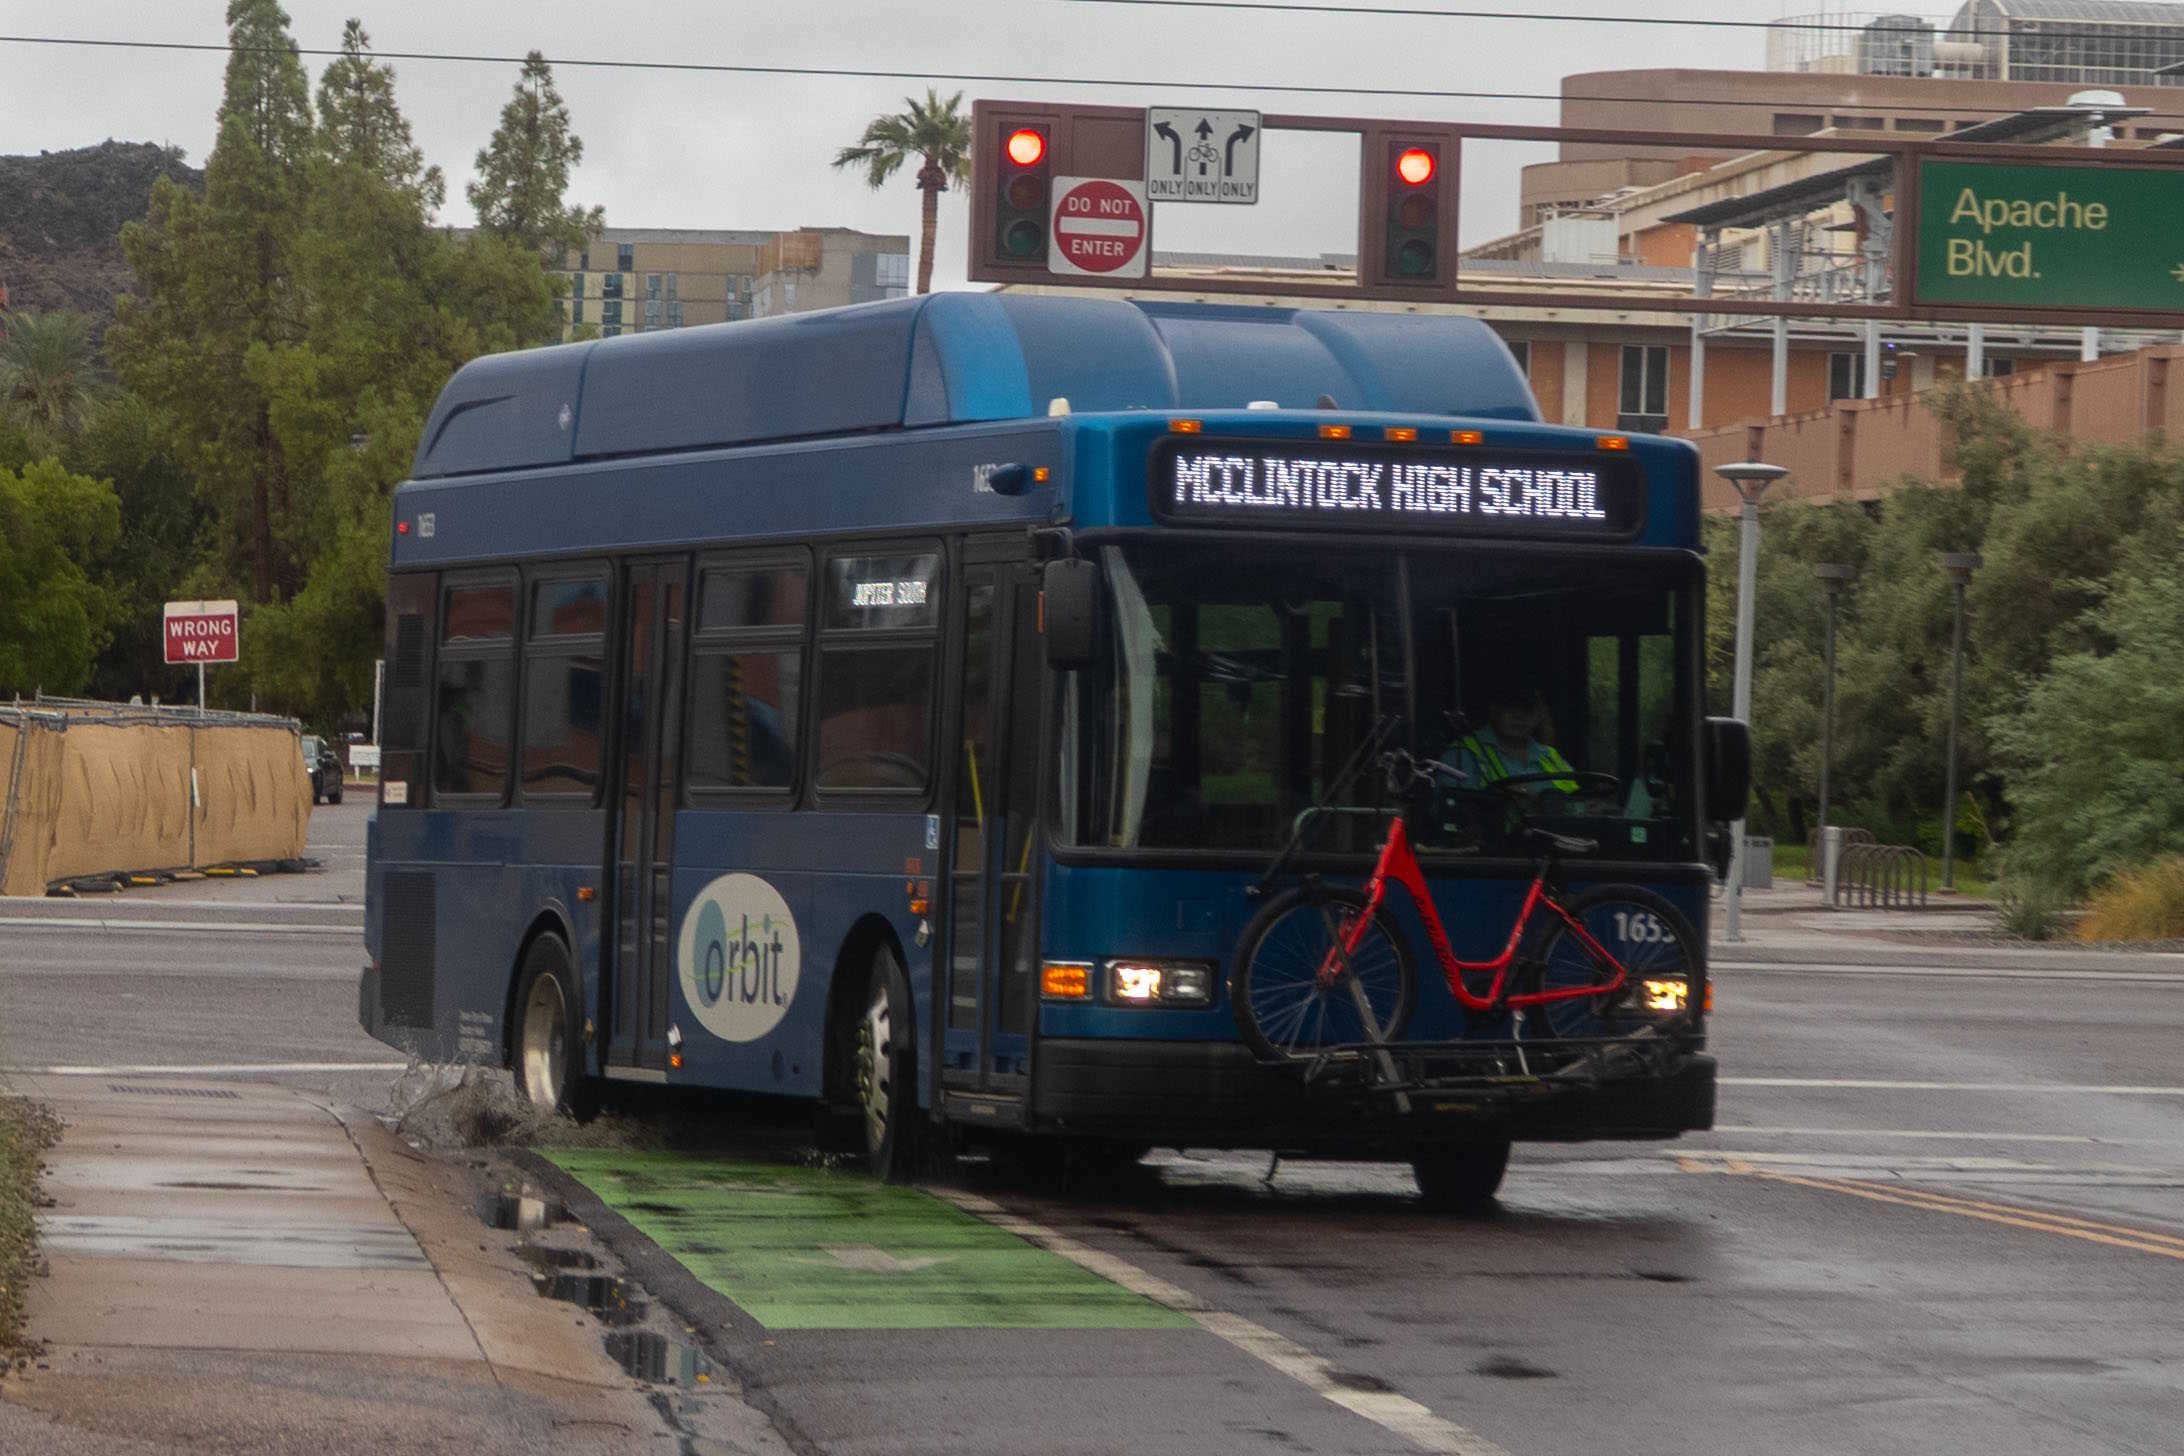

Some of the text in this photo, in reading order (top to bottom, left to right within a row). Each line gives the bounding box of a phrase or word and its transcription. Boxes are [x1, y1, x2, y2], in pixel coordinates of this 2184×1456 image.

[1151, 179, 1255, 197] ONLY ONLY ONLY
[1067, 197, 1132, 214] DO NOT
[1950, 188, 2108, 234] Apache
[1071, 239, 1125, 256] ENTER
[1947, 238, 2041, 278] Blvd.
[1175, 455, 1606, 518] MCCLINTOCK HIGH SCHOOL
[170, 620, 232, 637] WRONG
[183, 640, 219, 656] WAY
[706, 913, 784, 1006] orbit
